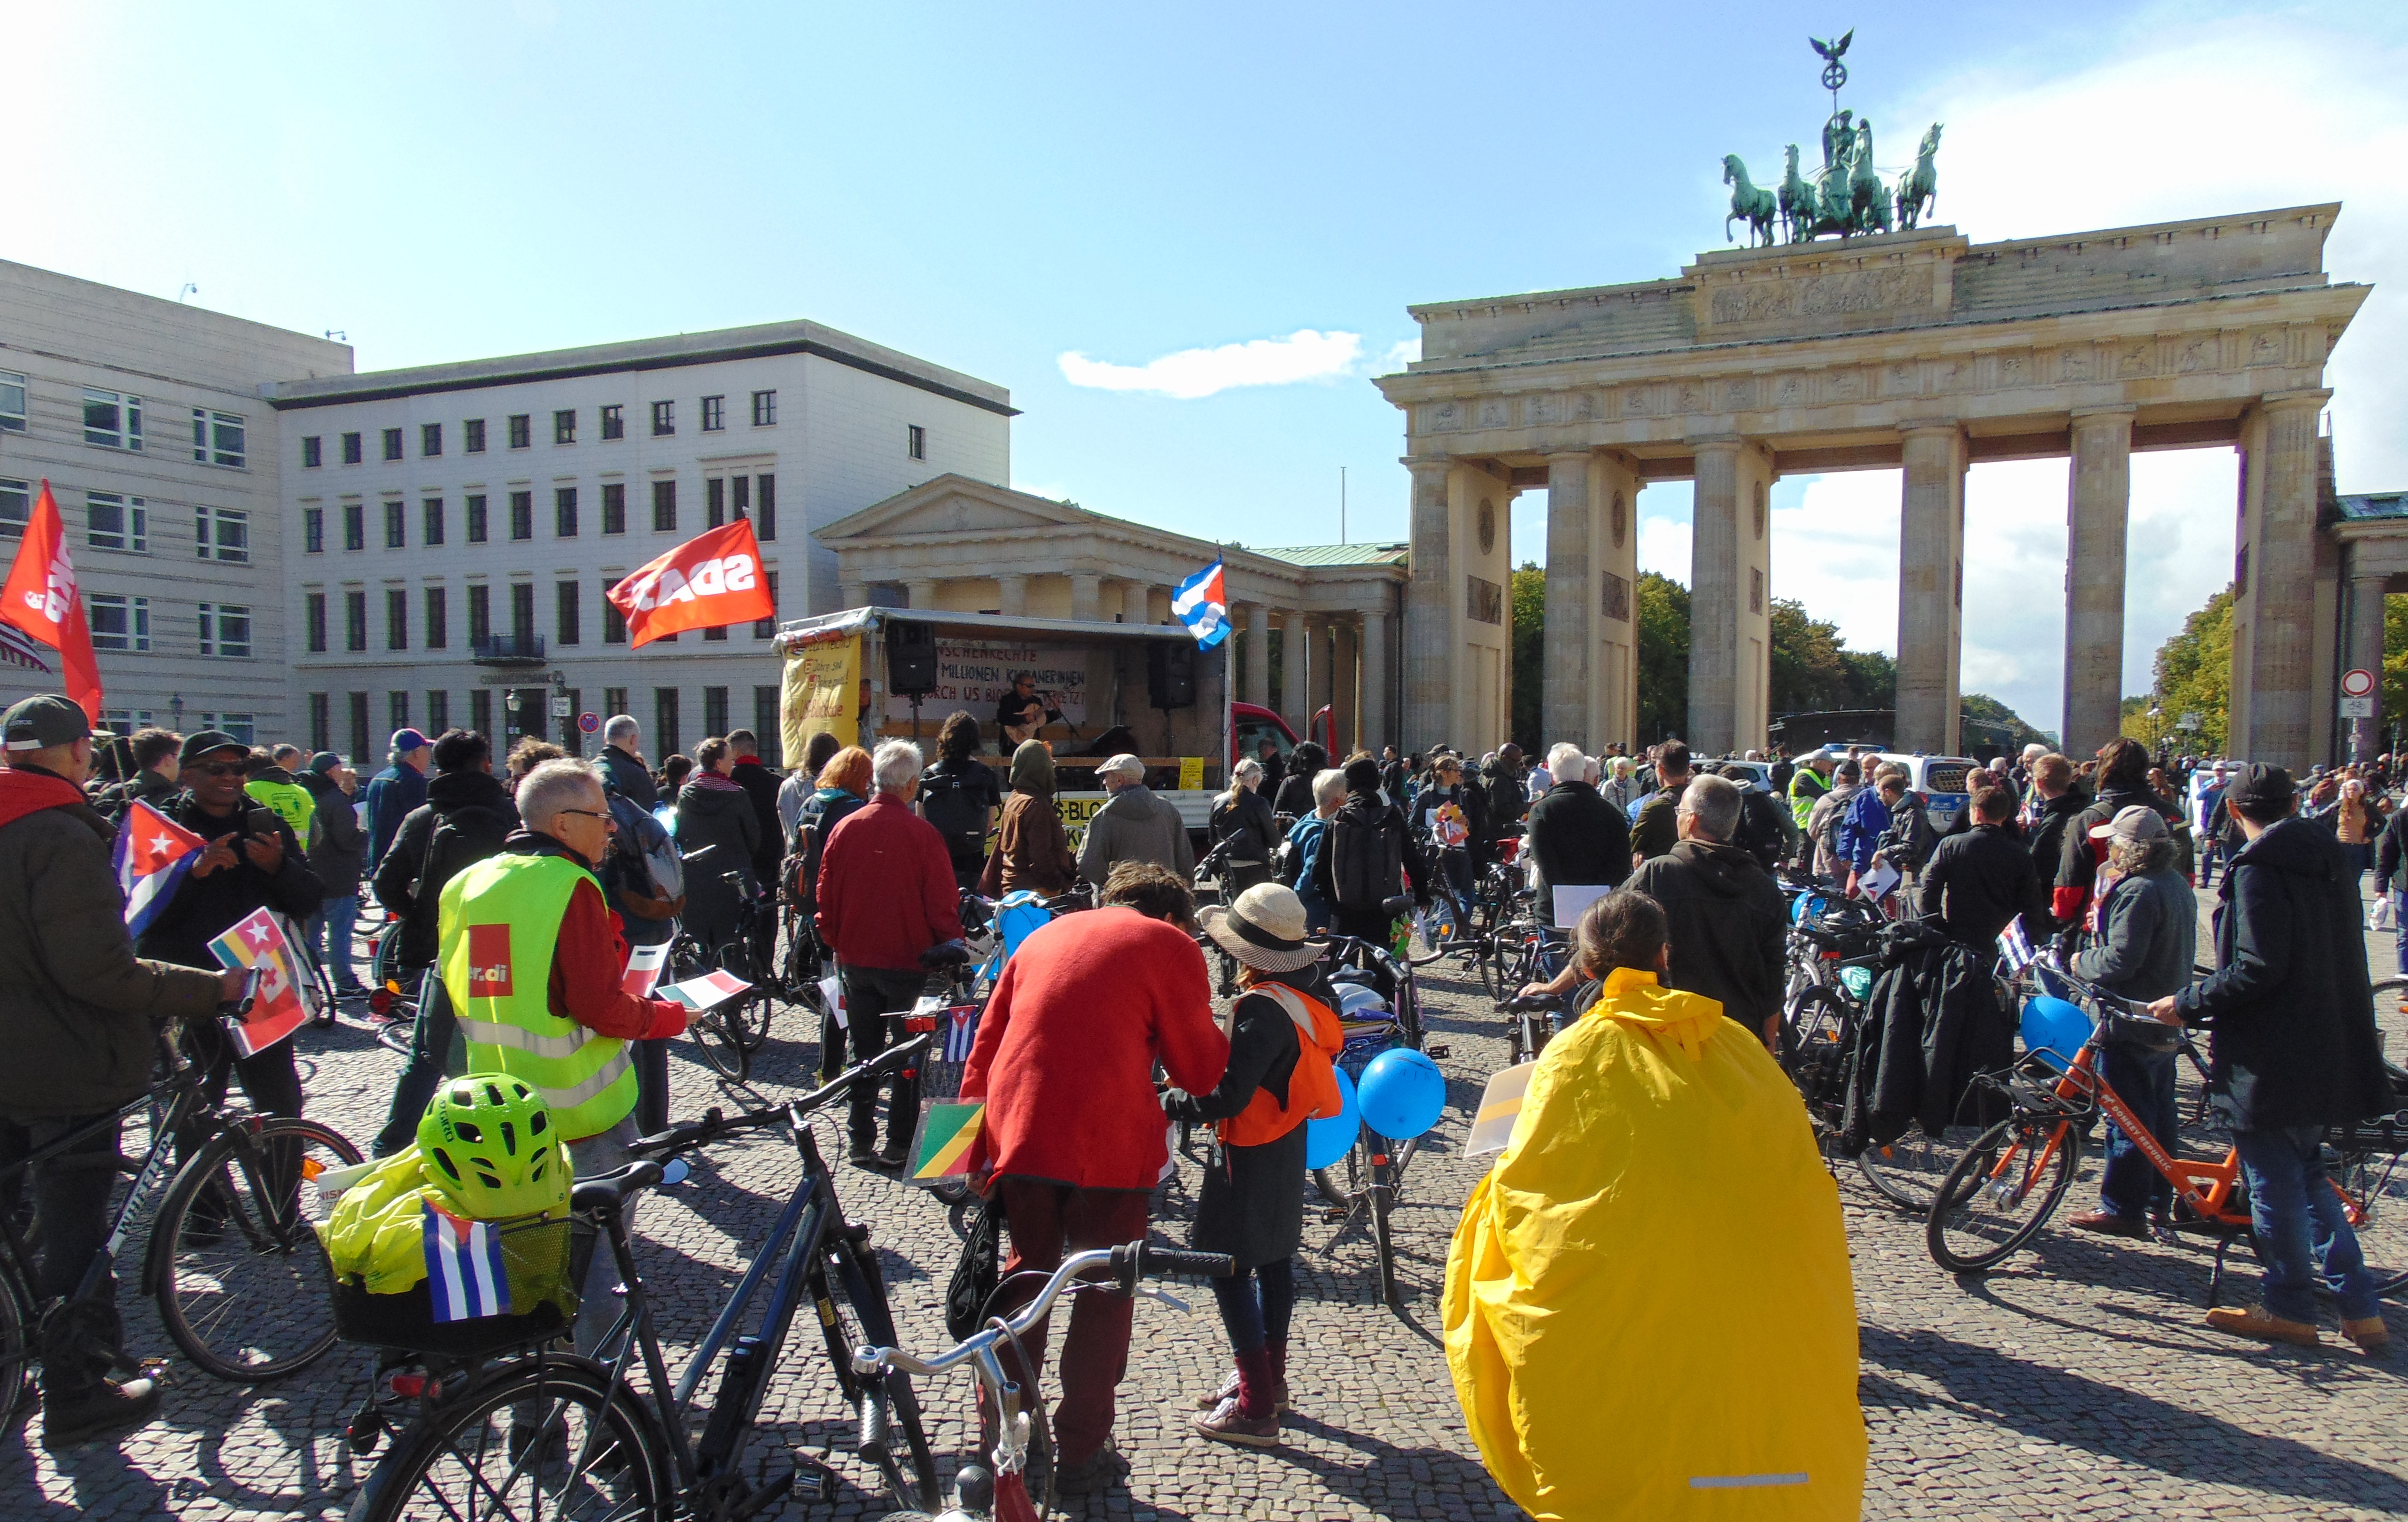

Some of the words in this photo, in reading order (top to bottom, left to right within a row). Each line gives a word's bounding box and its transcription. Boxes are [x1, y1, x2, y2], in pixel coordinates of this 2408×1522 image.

[941, 663, 999, 682] MILLIONEN
[964, 687, 979, 701] US
[2112, 1105, 2141, 1135] DONKEY
[2139, 1136, 2173, 1171] REPUBLIC
[117, 1139, 170, 1235] WHEELER
